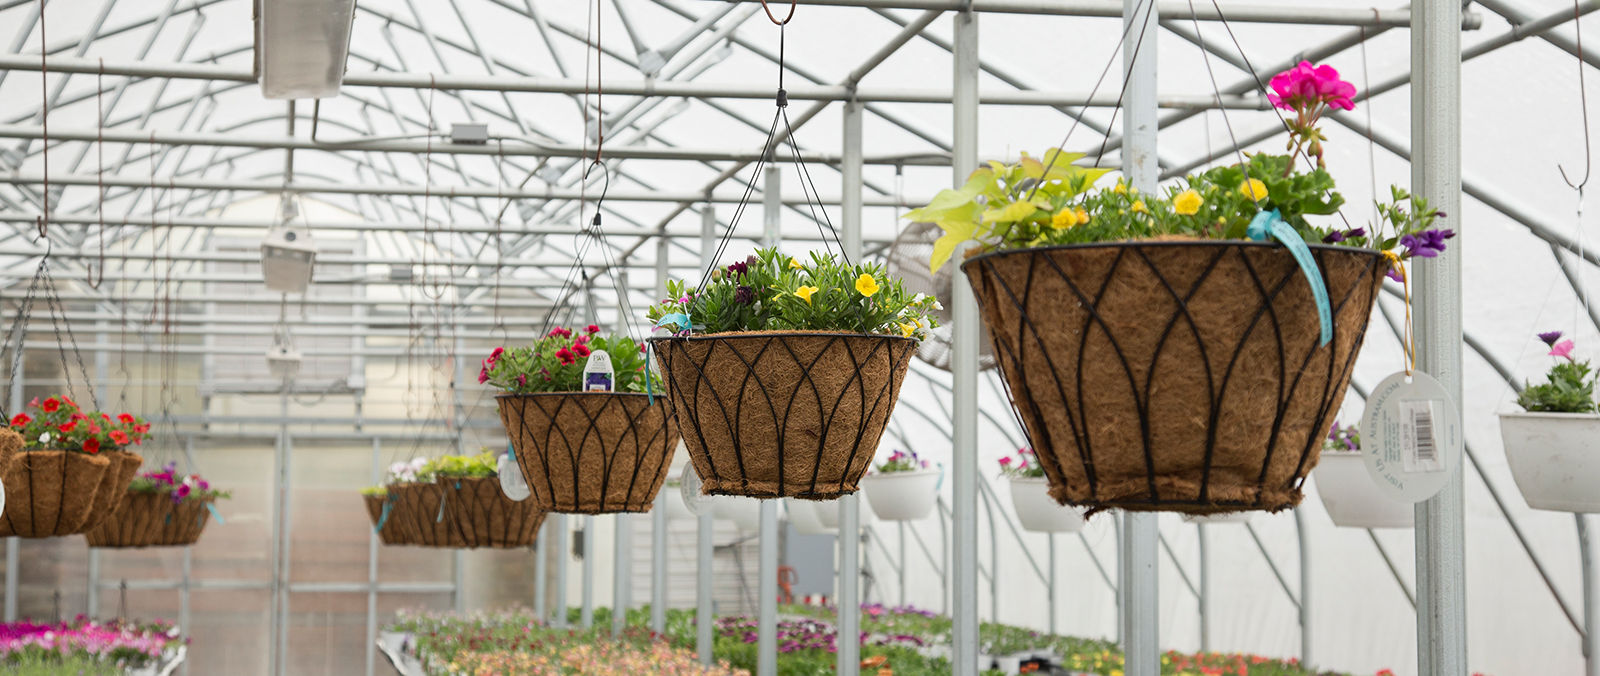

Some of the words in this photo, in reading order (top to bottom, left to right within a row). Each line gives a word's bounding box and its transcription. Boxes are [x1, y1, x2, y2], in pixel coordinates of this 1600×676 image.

[1371, 443, 1380, 455] AT
[1375, 459, 1386, 472] US
[1384, 473, 1404, 490] VISIT
